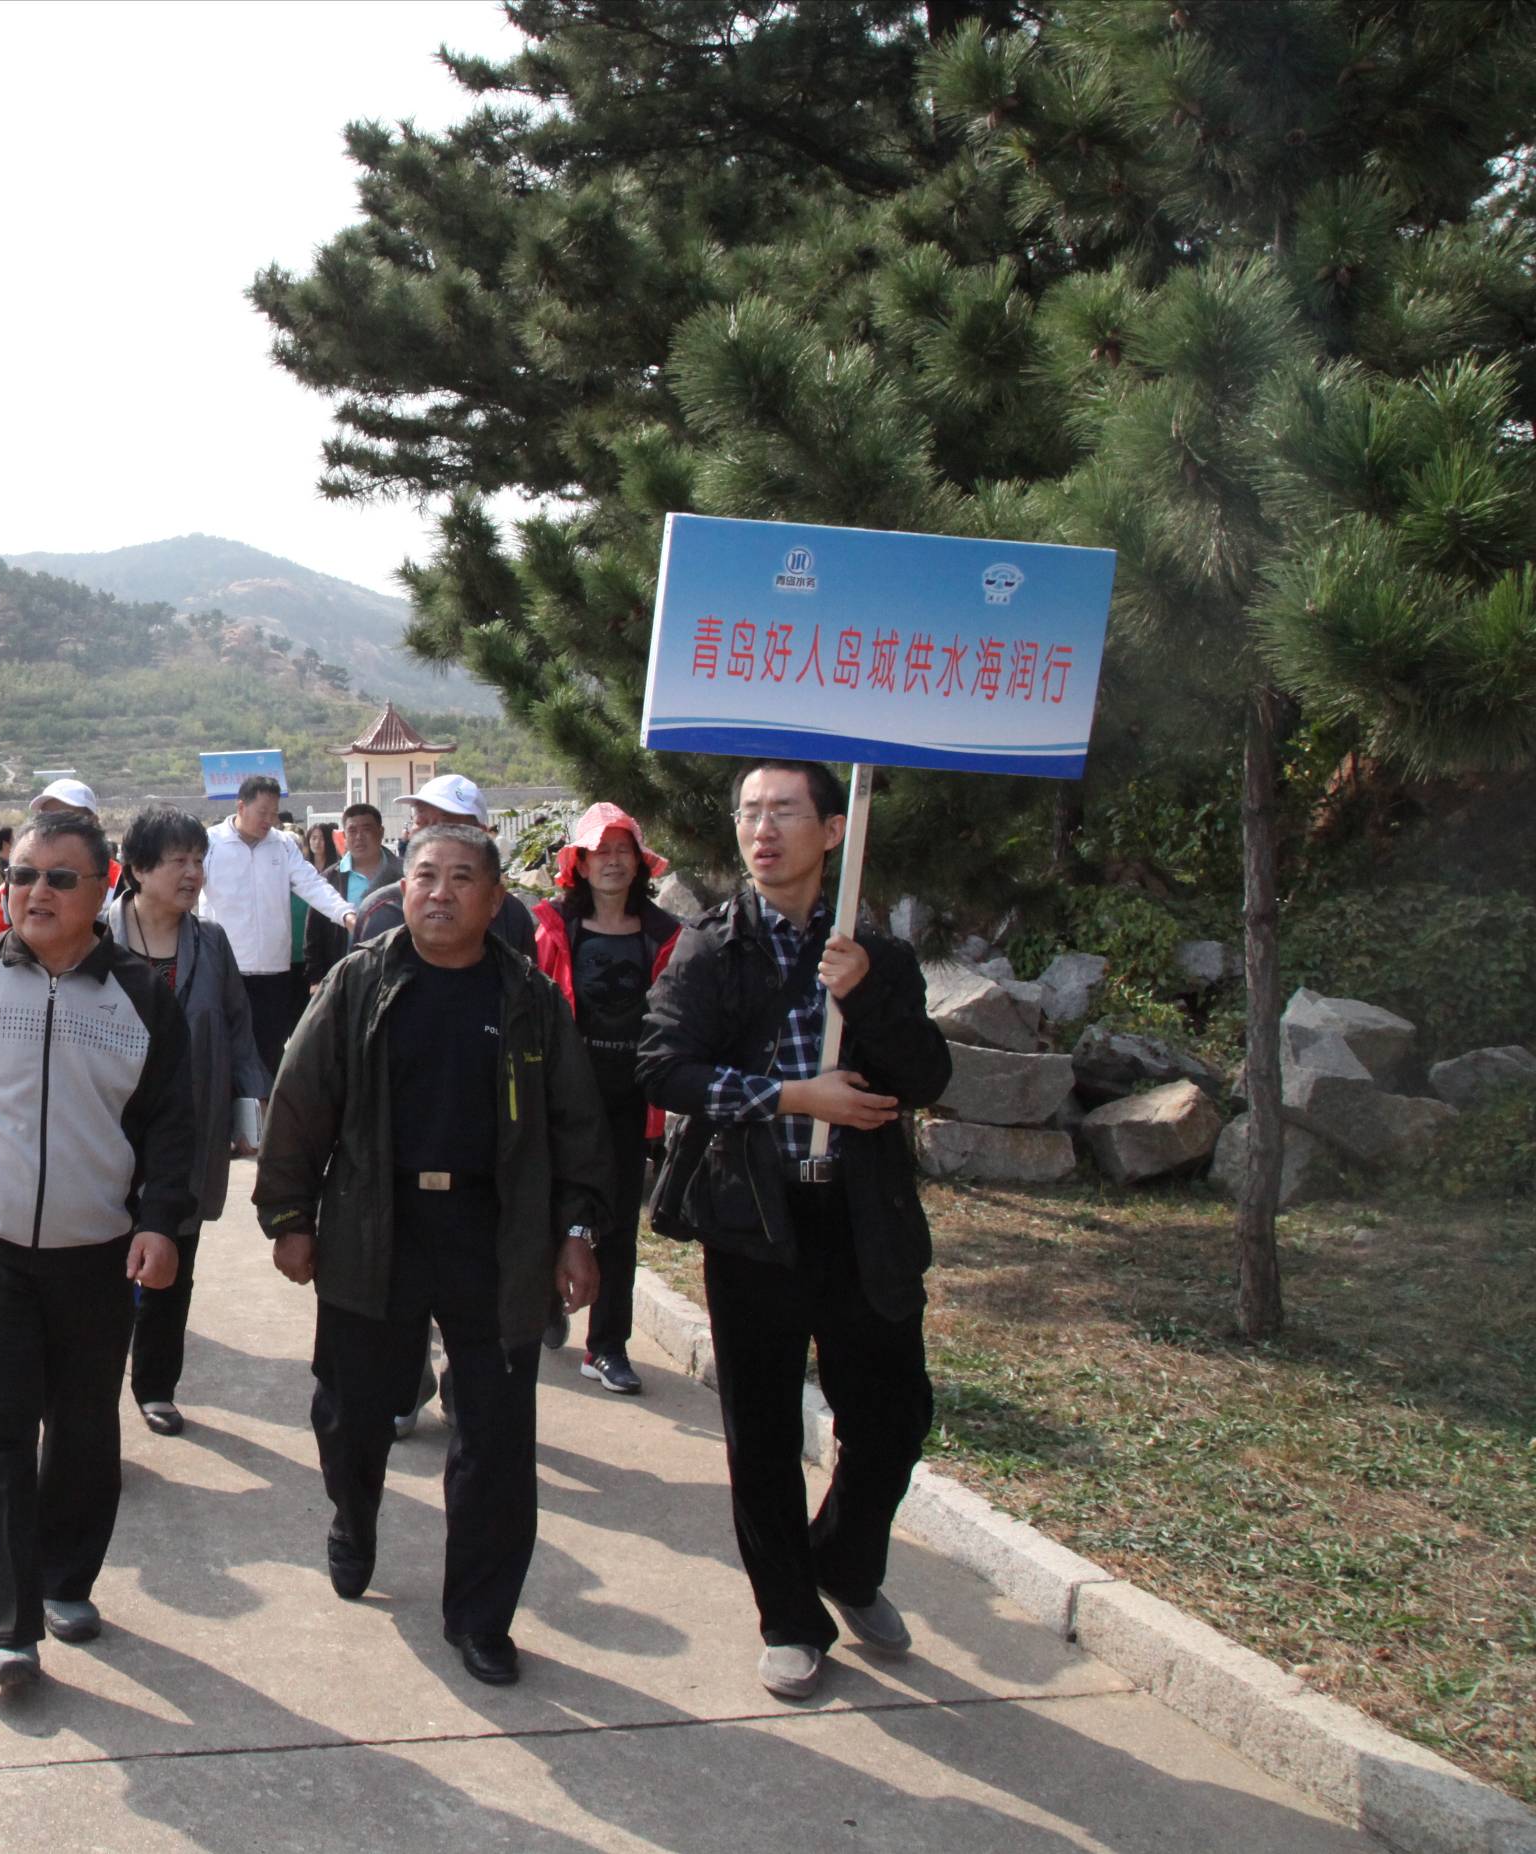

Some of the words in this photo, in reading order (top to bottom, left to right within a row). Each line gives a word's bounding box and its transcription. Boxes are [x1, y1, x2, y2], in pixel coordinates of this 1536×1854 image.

[691, 614, 1073, 703] 青岛好人岛城供水海润行
